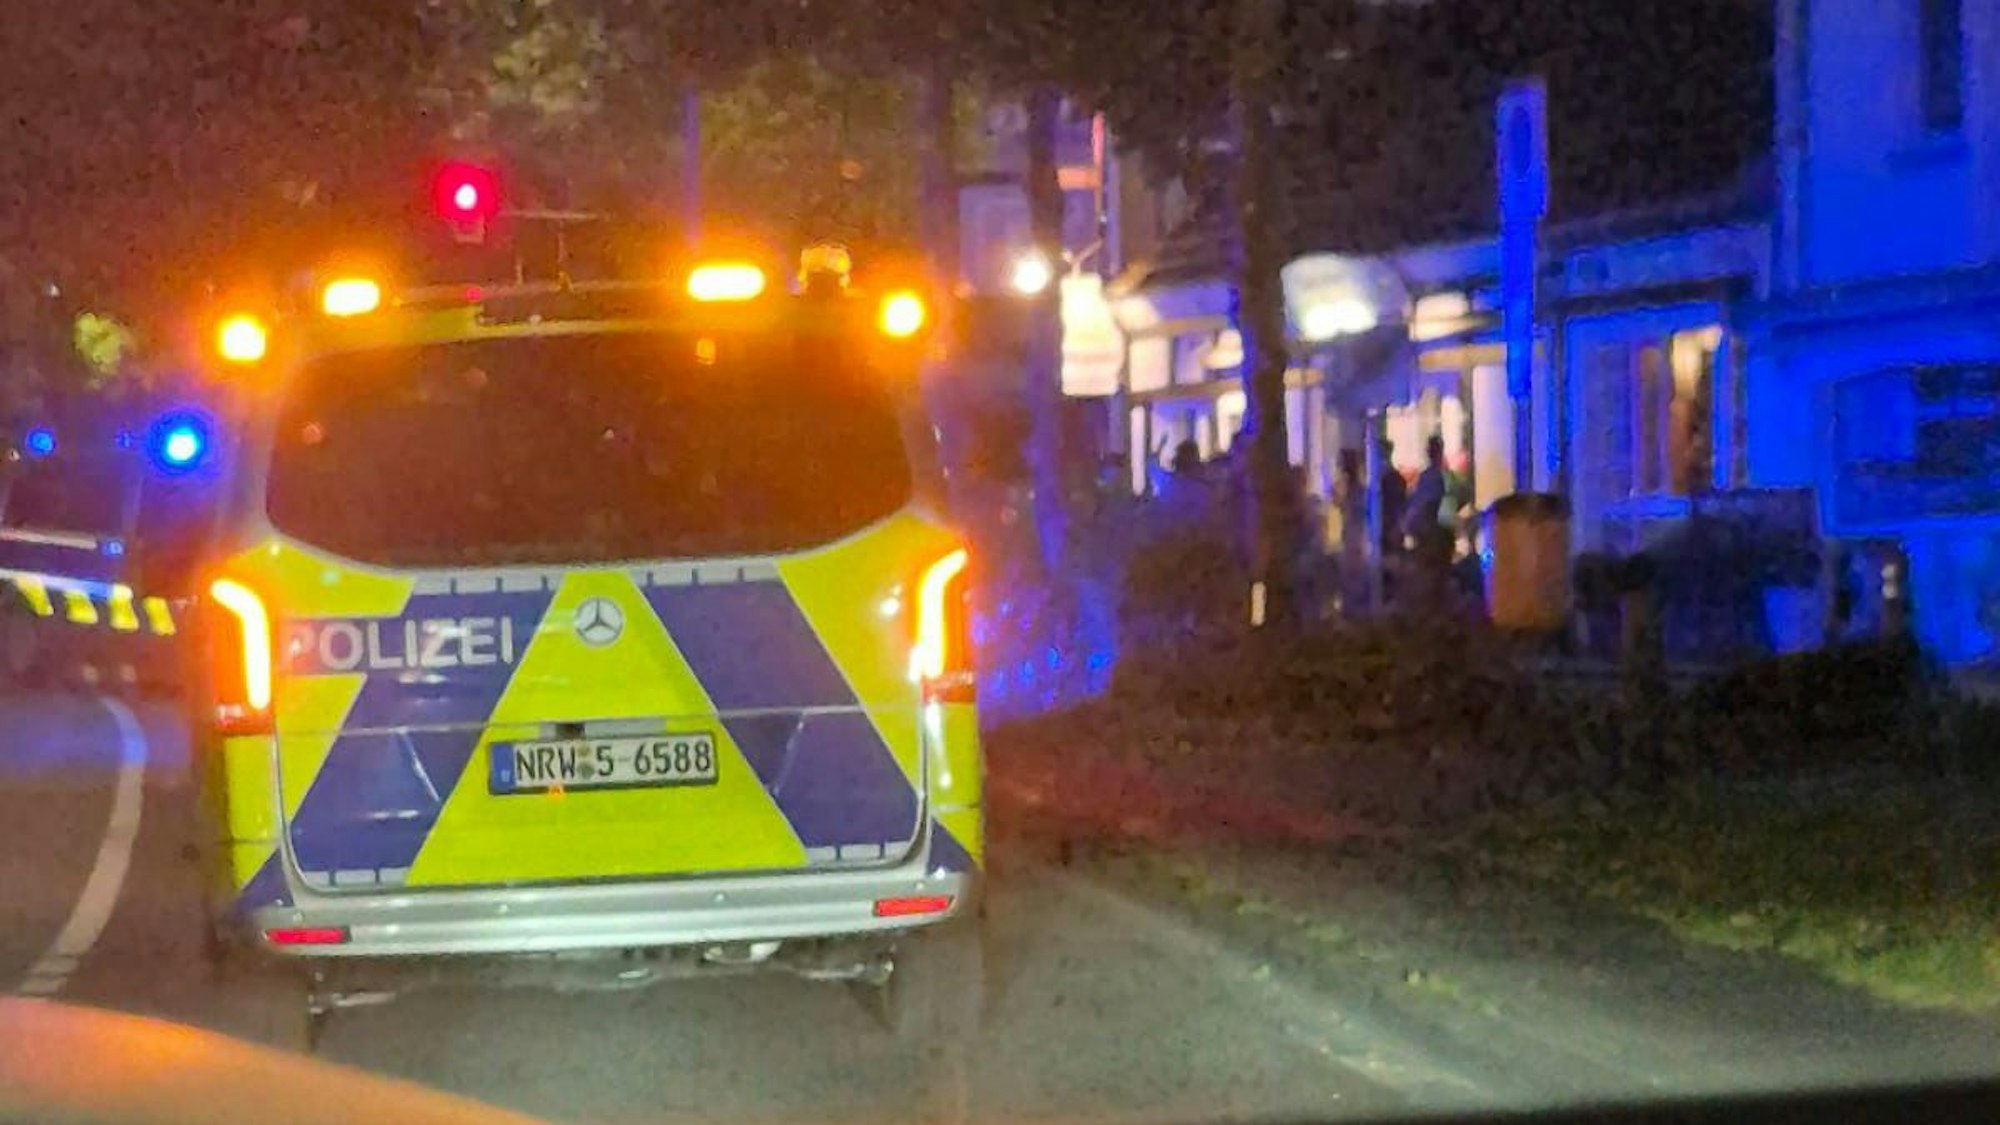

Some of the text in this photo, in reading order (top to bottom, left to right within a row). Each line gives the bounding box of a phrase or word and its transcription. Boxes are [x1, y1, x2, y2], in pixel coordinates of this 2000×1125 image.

[281, 617, 513, 670] POLIZEI
[515, 740, 711, 780] NRW 5-6588
